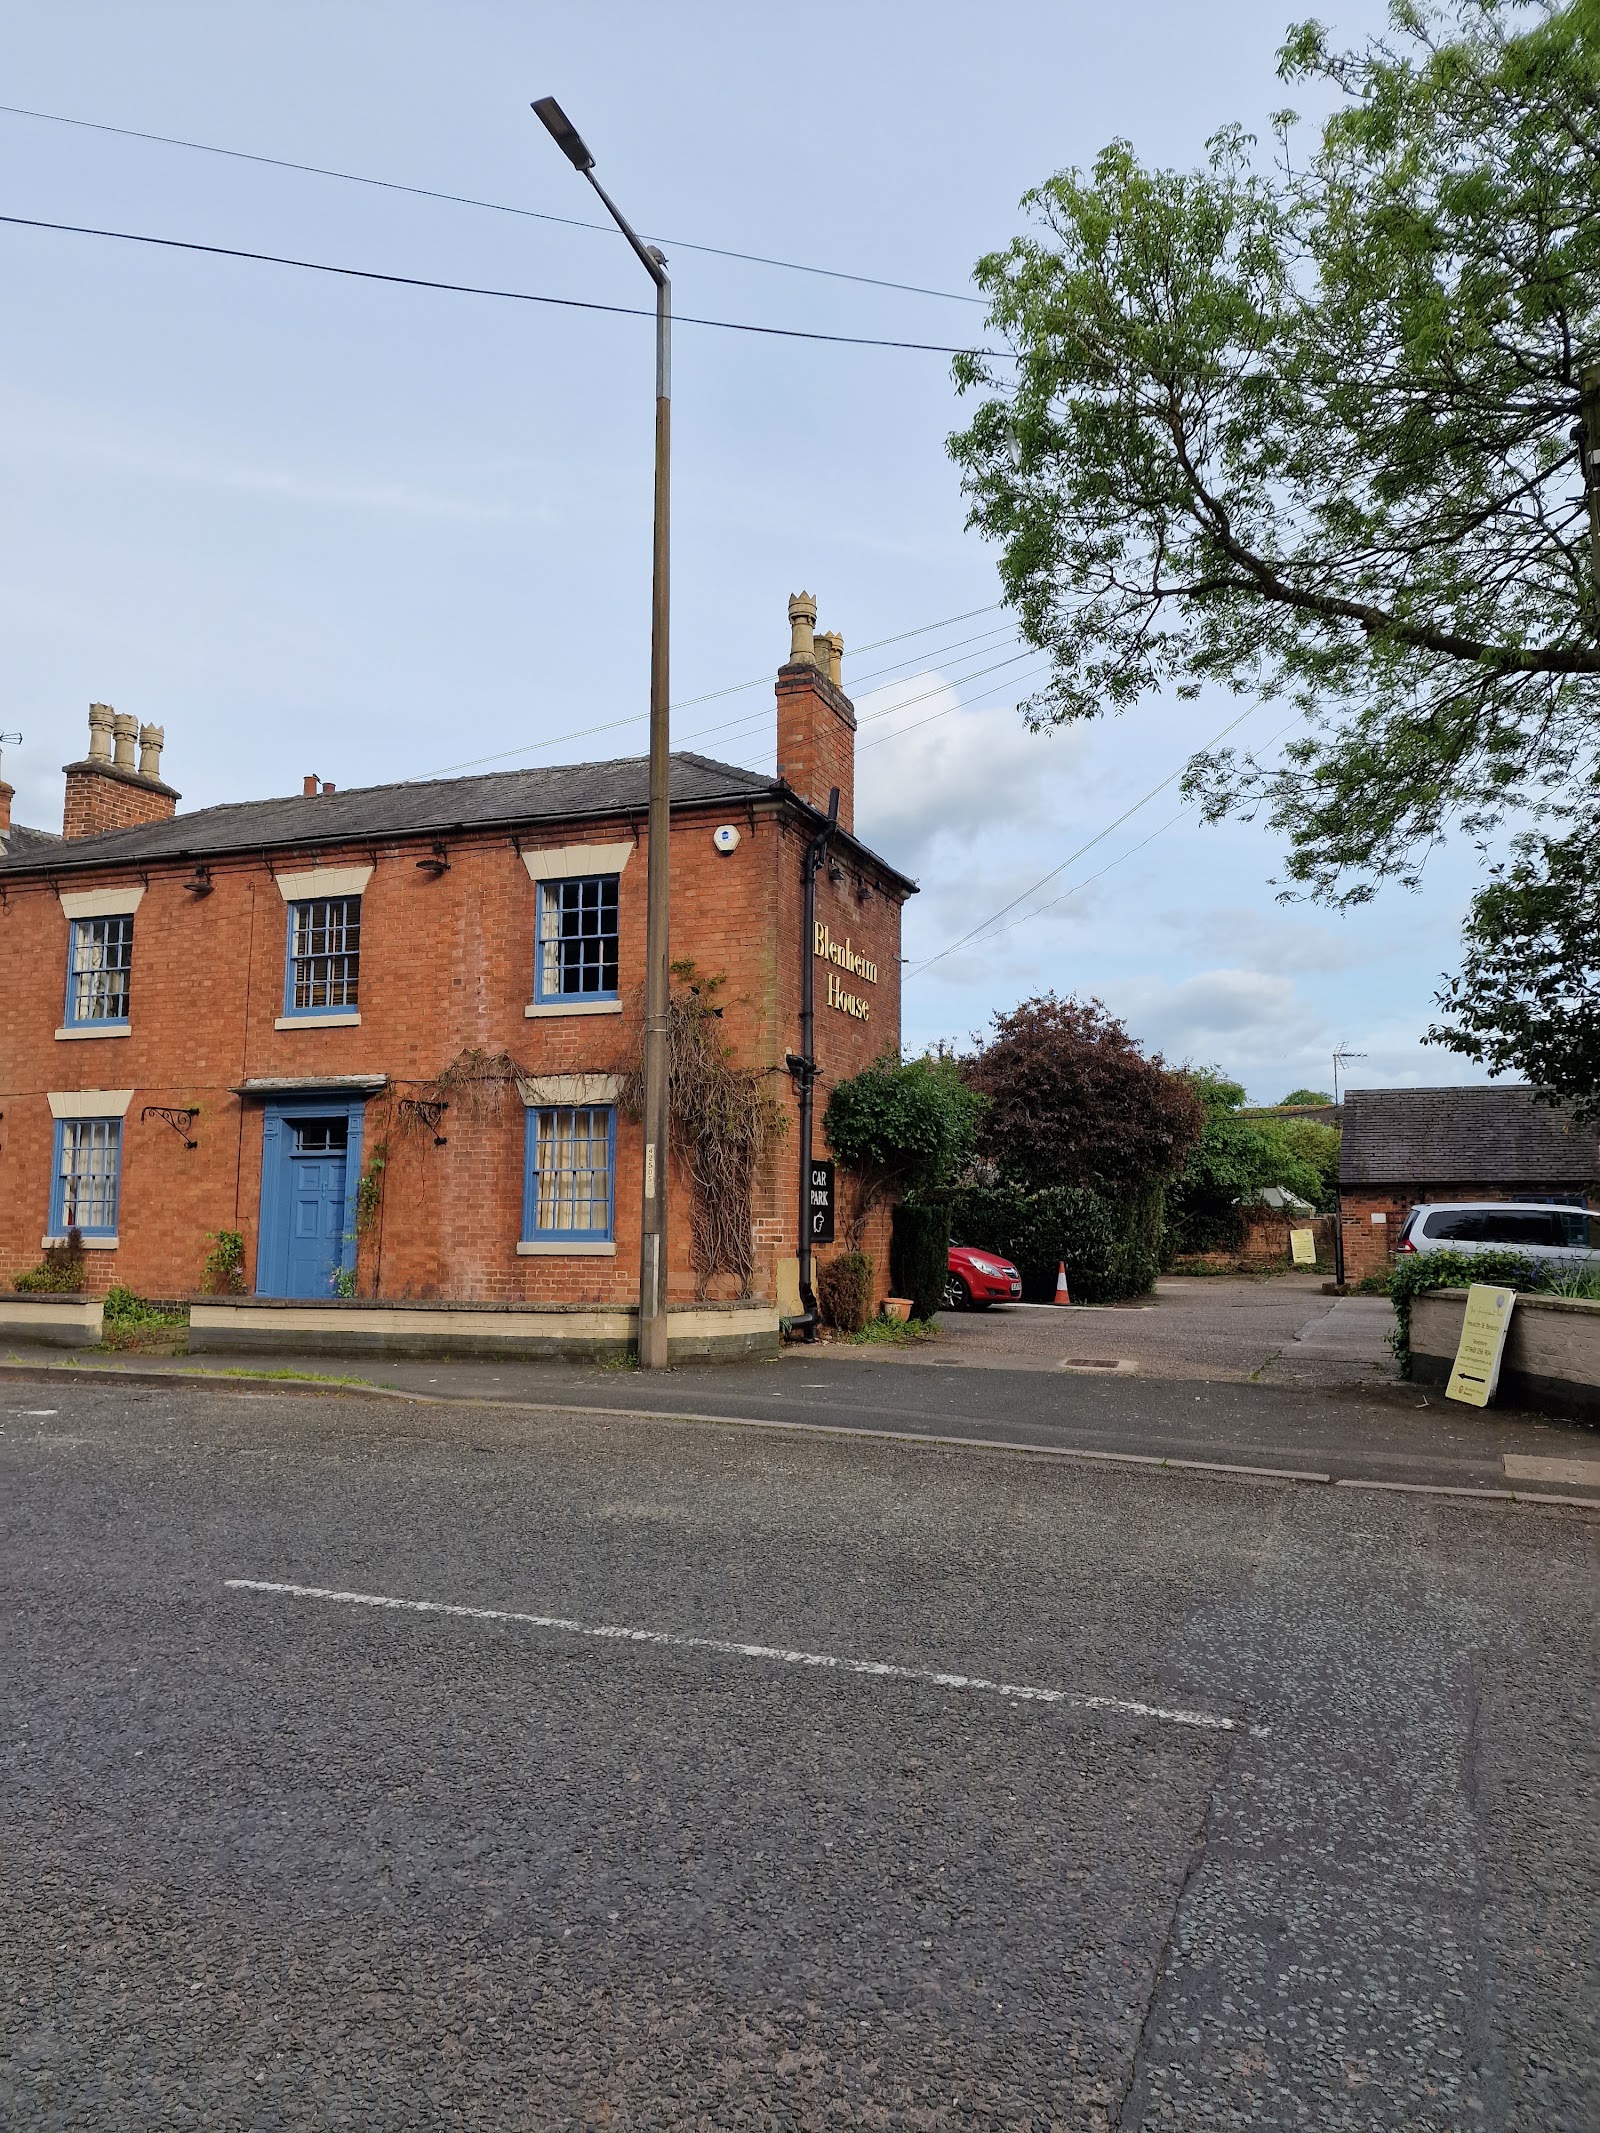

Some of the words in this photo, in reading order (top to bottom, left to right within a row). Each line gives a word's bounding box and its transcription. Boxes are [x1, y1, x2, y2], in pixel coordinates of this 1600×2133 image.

[813, 920, 878, 984] Blenheim
[827, 972, 870, 1021] House
[812, 1170, 827, 1186] CAR
[810, 1190, 829, 1206] PARK
